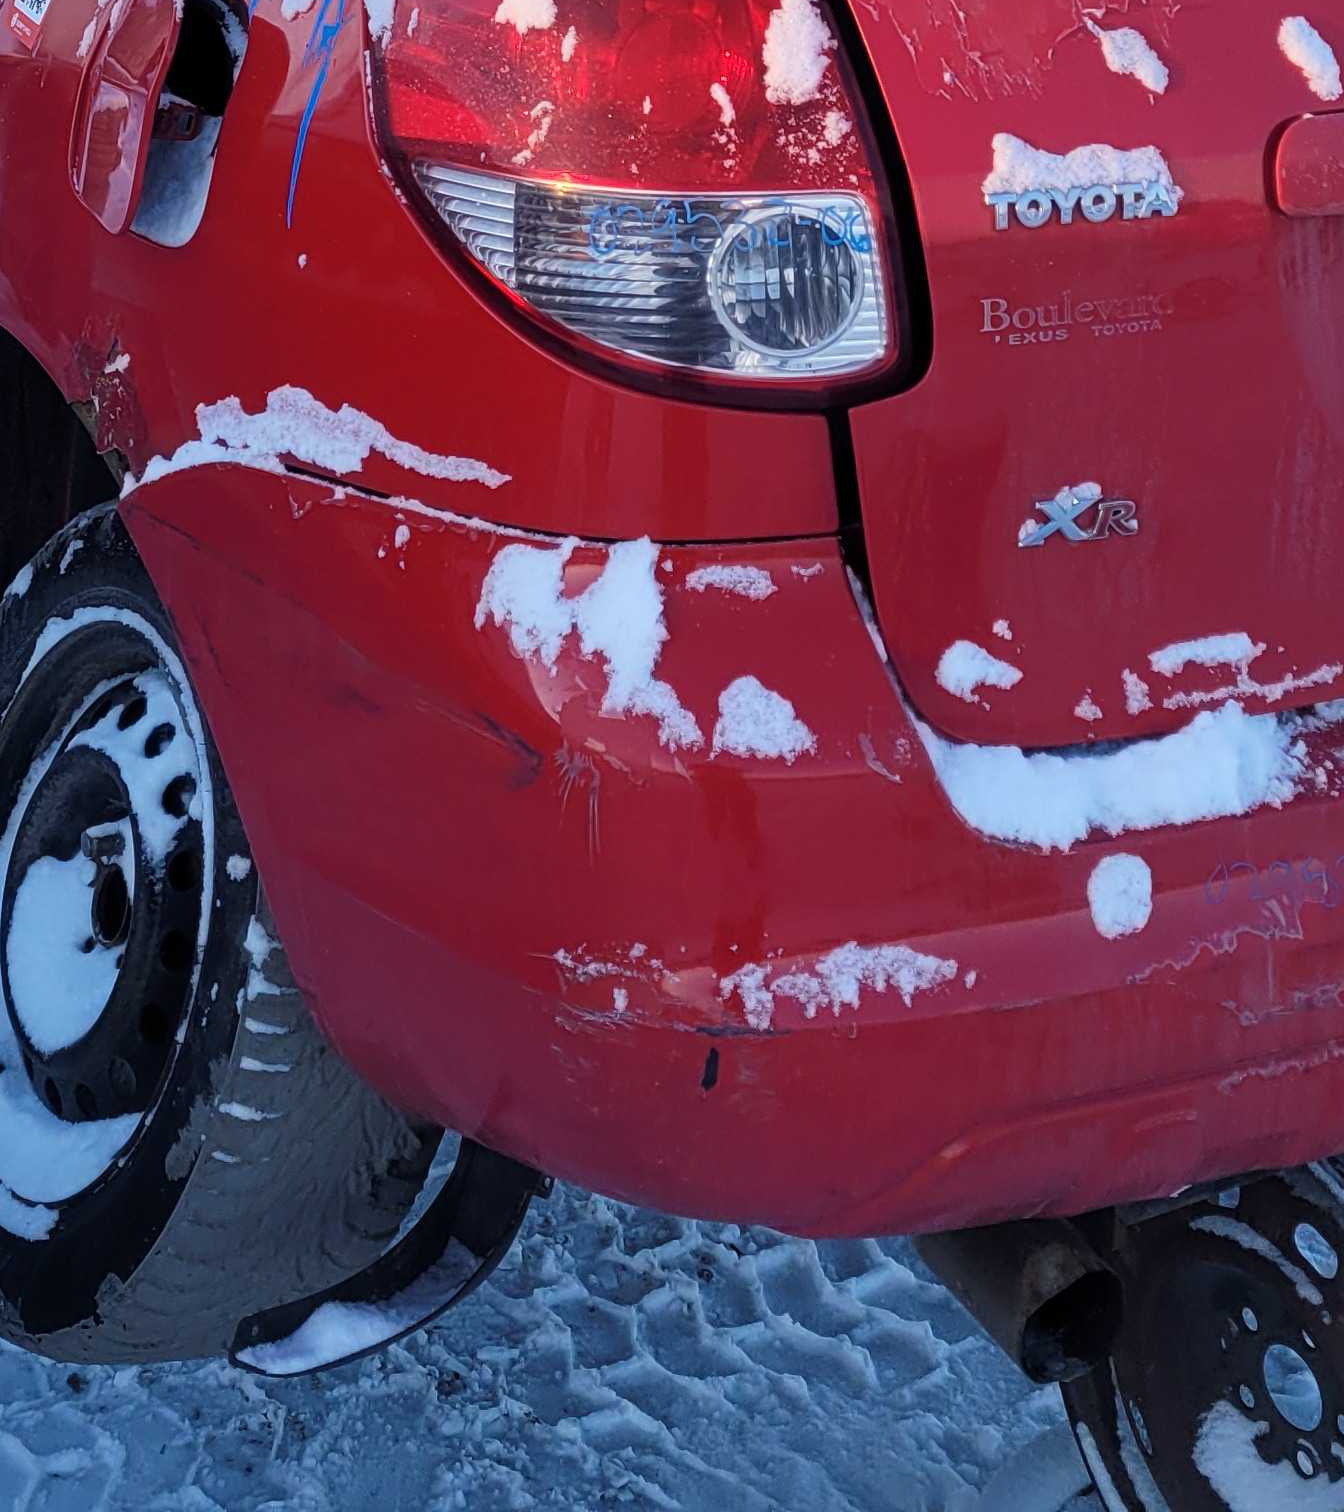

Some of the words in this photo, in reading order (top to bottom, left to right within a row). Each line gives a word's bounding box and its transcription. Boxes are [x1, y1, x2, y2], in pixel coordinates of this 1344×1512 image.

[985, 182, 1178, 231] TOYOTA
[993, 328, 1070, 346] EXUS
[1090, 319, 1164, 337] TOYOTA
[1017, 485, 1139, 548] XR
